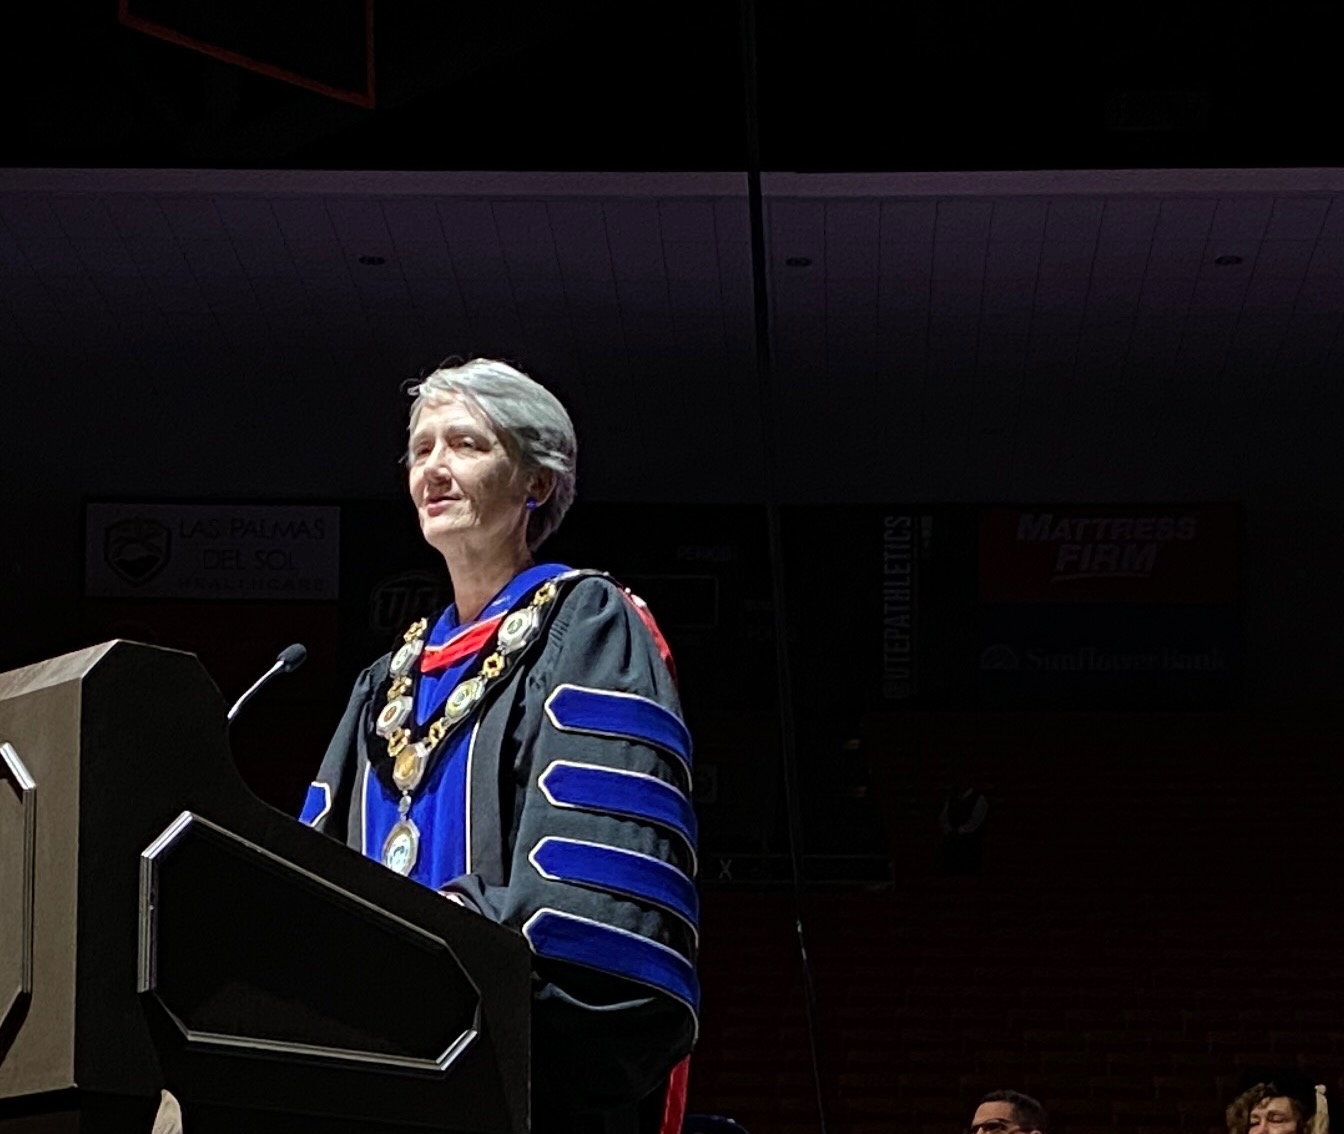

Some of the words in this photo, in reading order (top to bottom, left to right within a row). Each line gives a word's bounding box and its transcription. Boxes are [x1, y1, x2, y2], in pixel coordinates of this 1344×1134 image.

[179, 518, 221, 540] LAS
[230, 518, 326, 541] PALMAS
[1015, 512, 1198, 542] MATTRESS
[203, 549, 246, 571] DEL
[255, 549, 299, 571] SOL
[1055, 543, 1157, 573] FIRM
[1159, 645, 1230, 671] Bank
